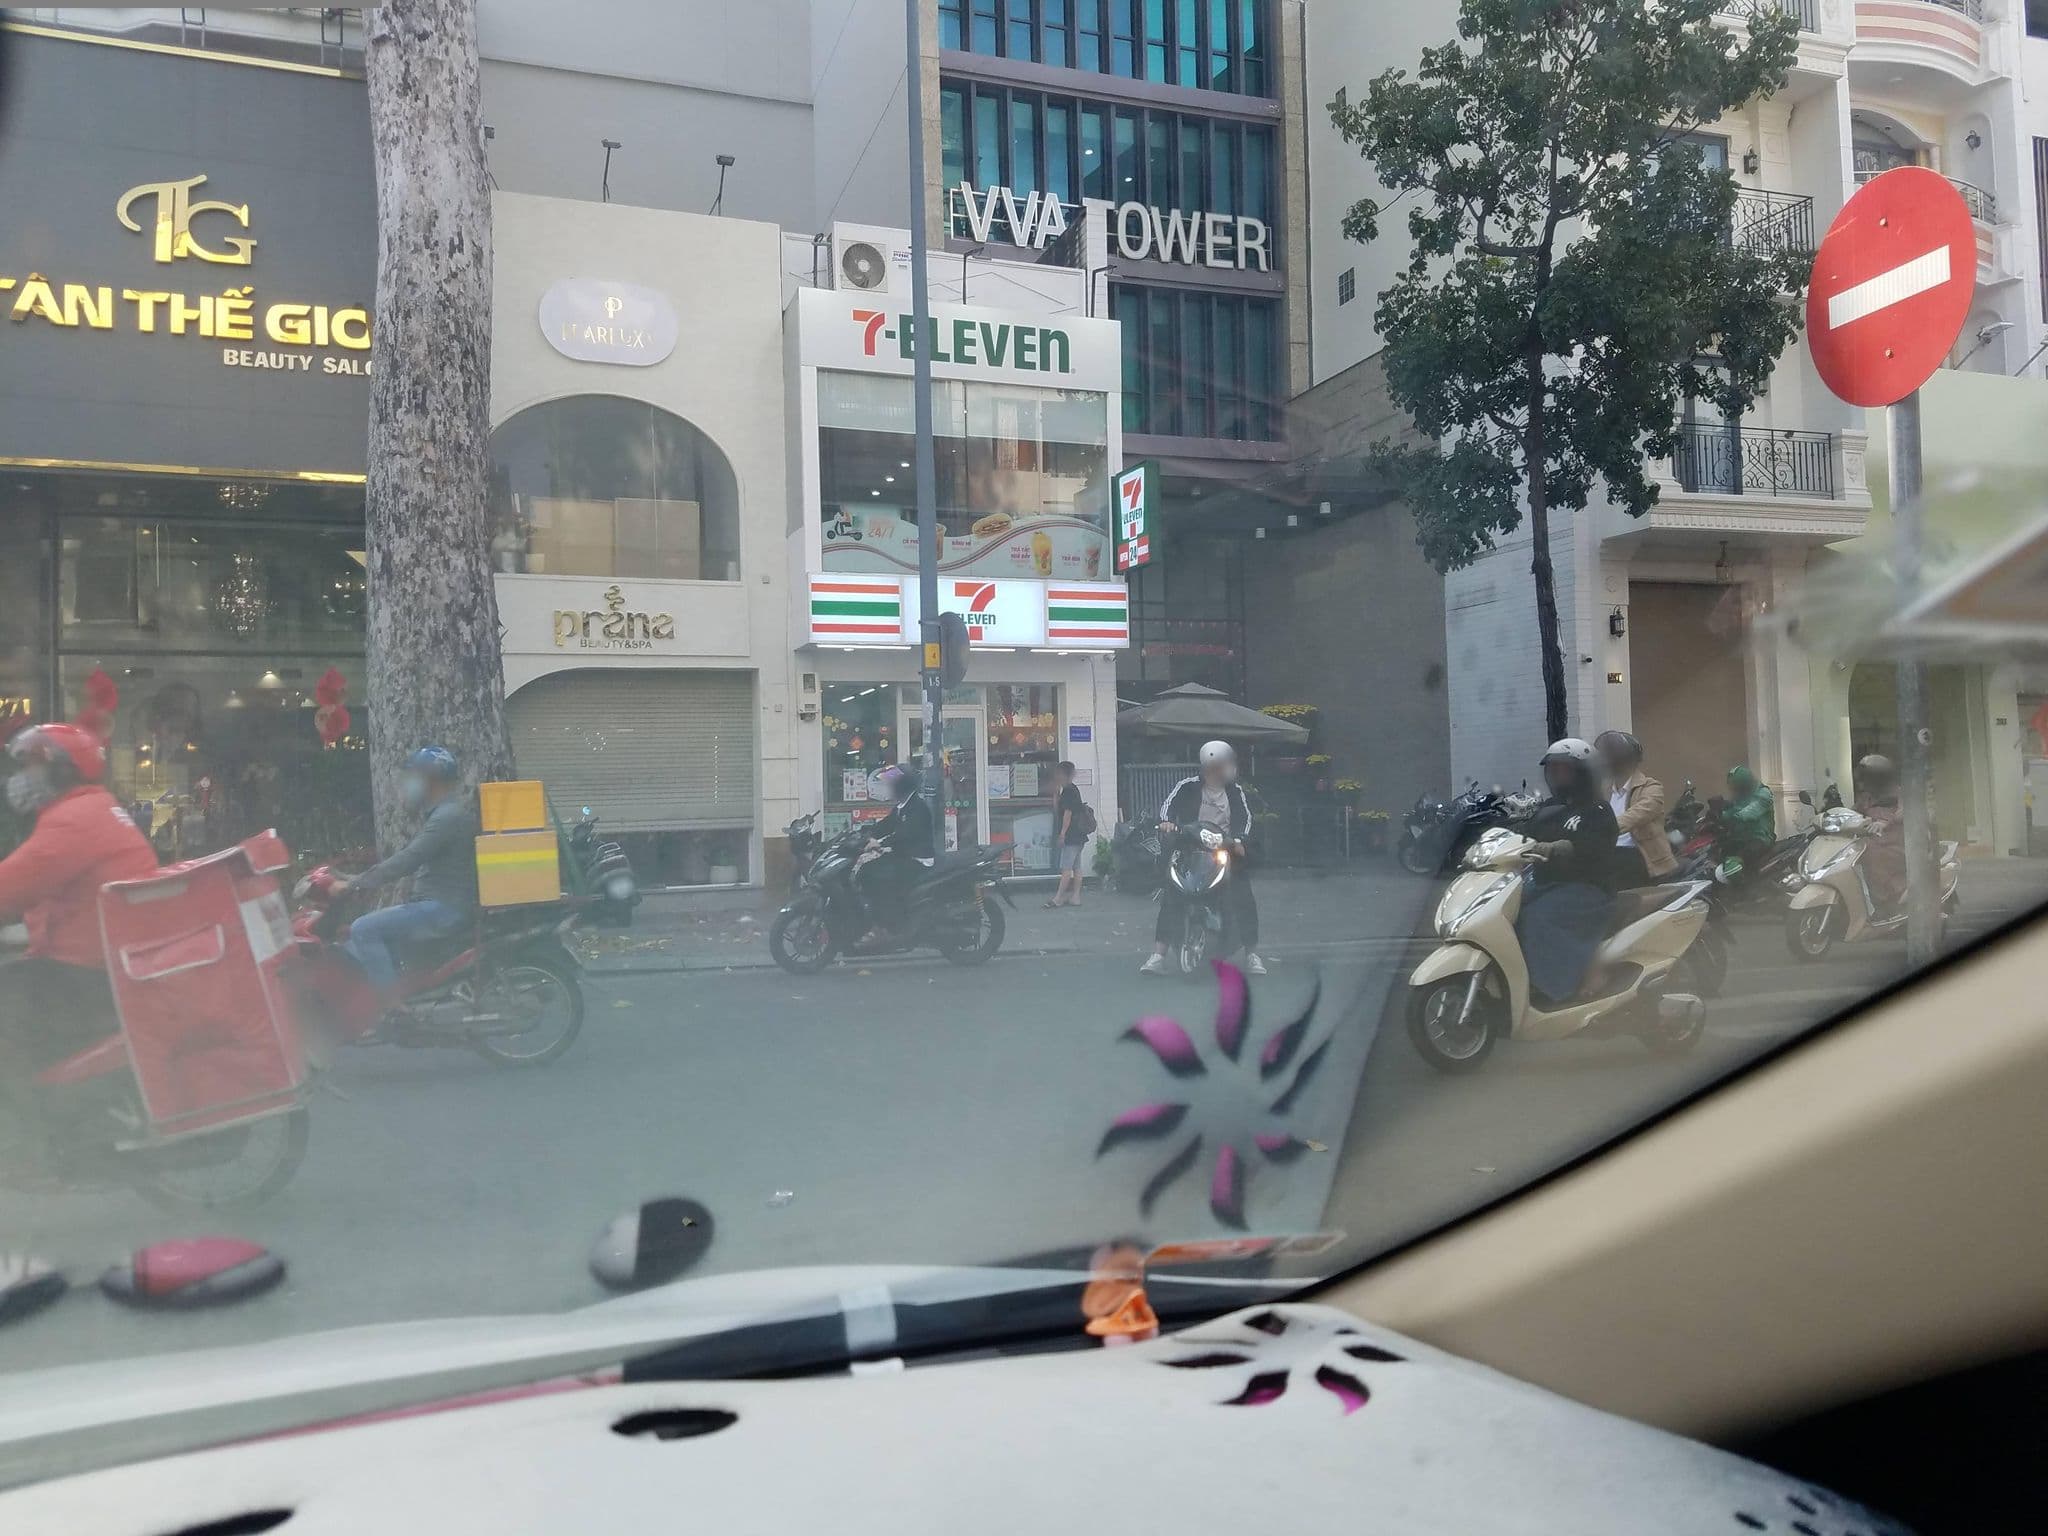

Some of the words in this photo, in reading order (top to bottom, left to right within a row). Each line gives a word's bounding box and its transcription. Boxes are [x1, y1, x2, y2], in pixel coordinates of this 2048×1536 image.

[960, 181, 1067, 249] VVA
[1081, 196, 1268, 273] TOWER
[122, 286, 254, 341] THẾ
[223, 348, 313, 371] BEAUTY
[1129, 546, 1137, 561] 24
